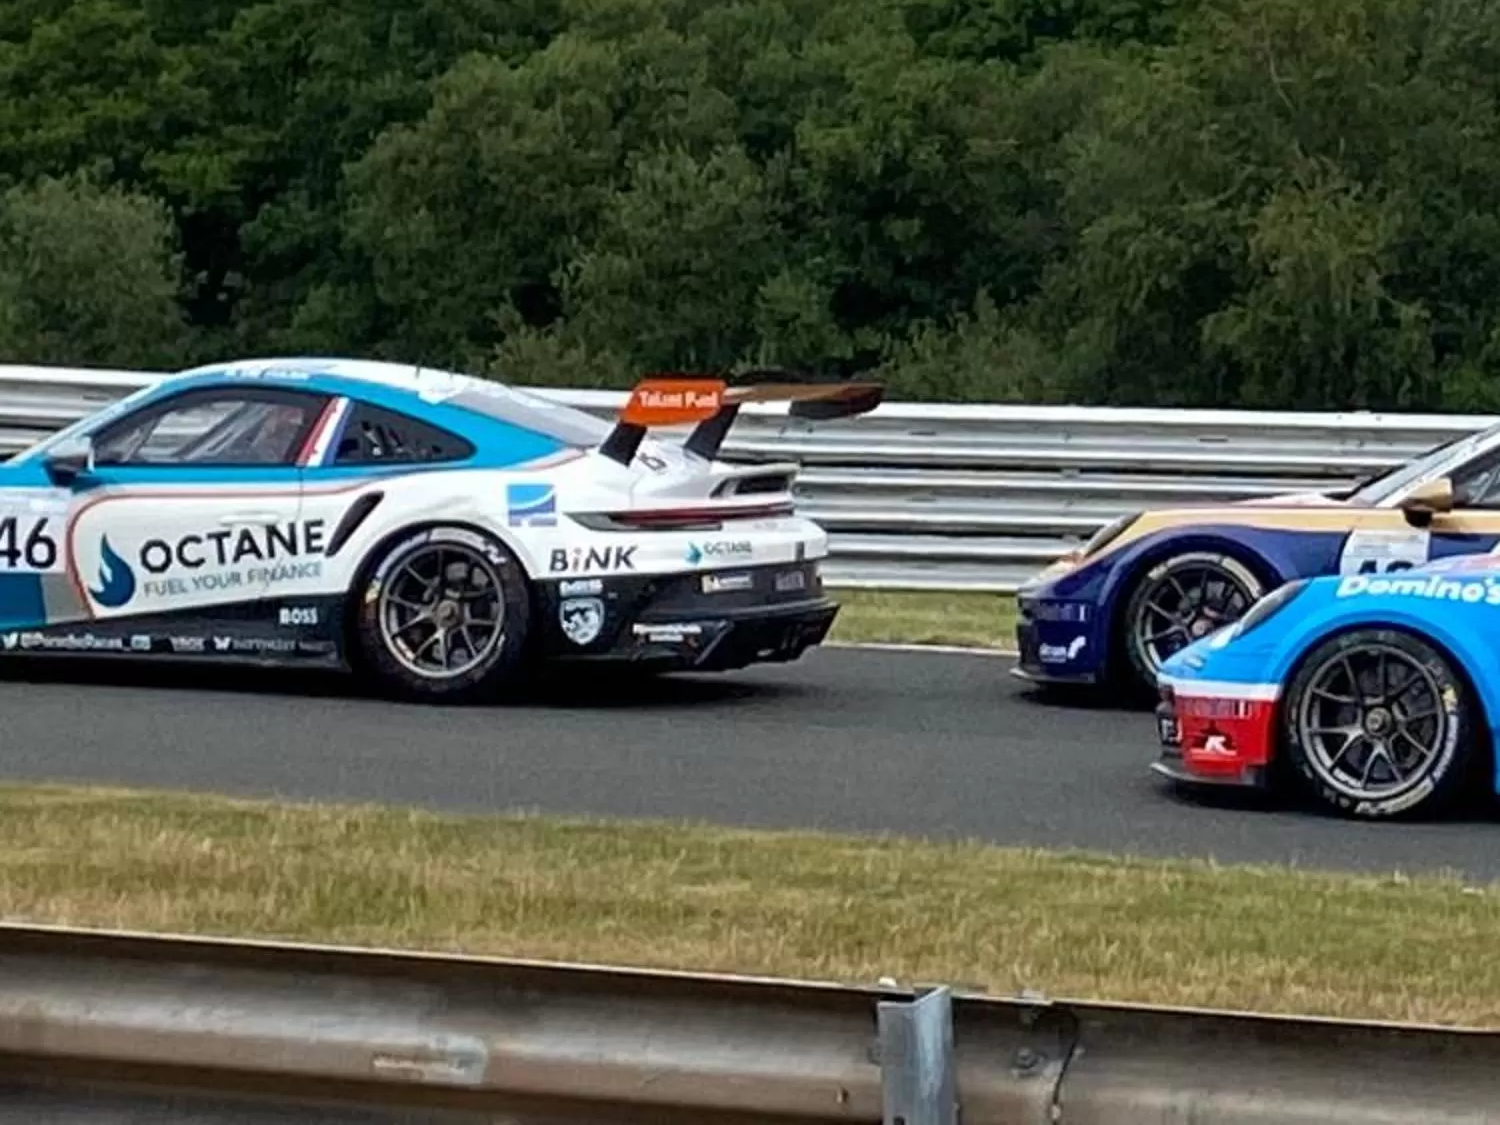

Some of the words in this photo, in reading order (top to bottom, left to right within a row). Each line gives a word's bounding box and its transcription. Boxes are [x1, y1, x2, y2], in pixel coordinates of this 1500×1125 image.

[0, 516, 57, 569] 46
[139, 519, 325, 574] OCTANE
[143, 577, 188, 598] FUEL
[191, 572, 241, 592] YOUR
[246, 560, 323, 587] FINANCE
[279, 606, 318, 624] BOSS
